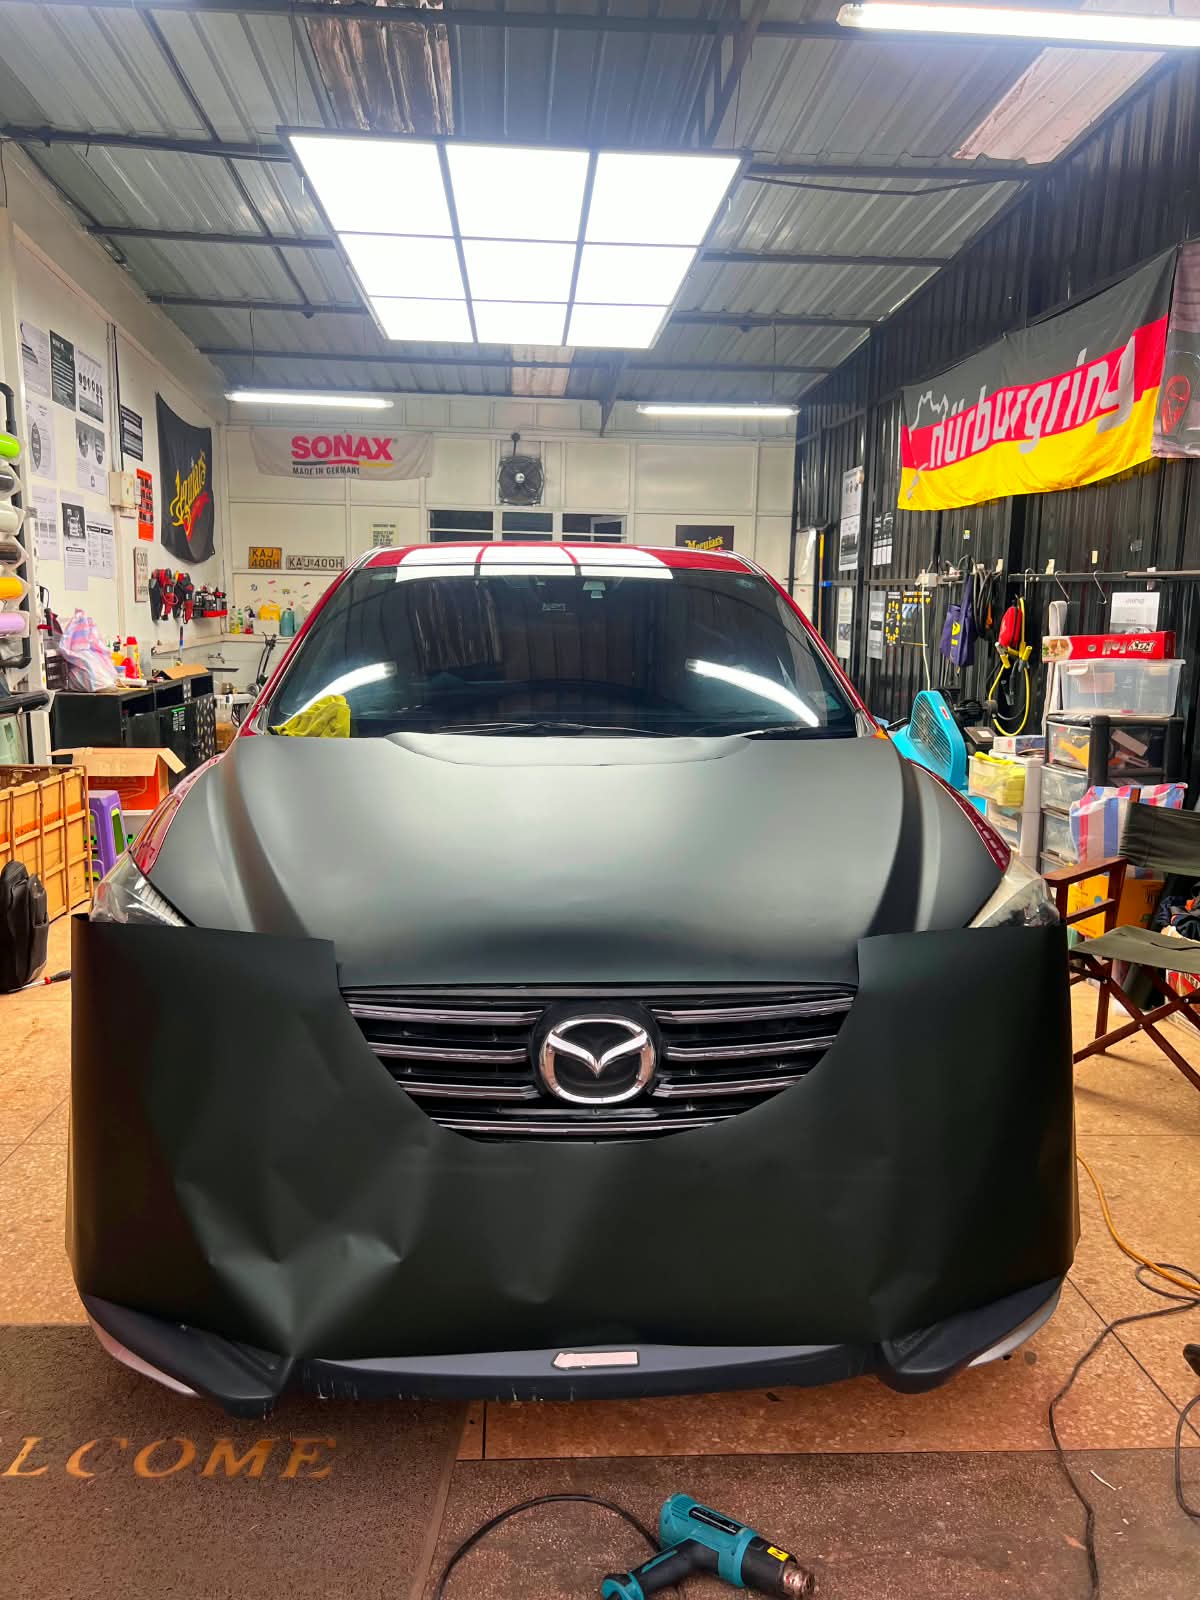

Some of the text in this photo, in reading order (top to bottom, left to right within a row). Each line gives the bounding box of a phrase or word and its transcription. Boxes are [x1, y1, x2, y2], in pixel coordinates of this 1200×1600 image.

[291, 433, 393, 461] SONAX
[292, 466, 360, 475] MADE IN GERMANY
[252, 549, 274, 558] KAJ
[251, 559, 280, 568] 400H
[289, 558, 343, 568] KAJ 400H
[0, 1437, 337, 1479] LCOME
